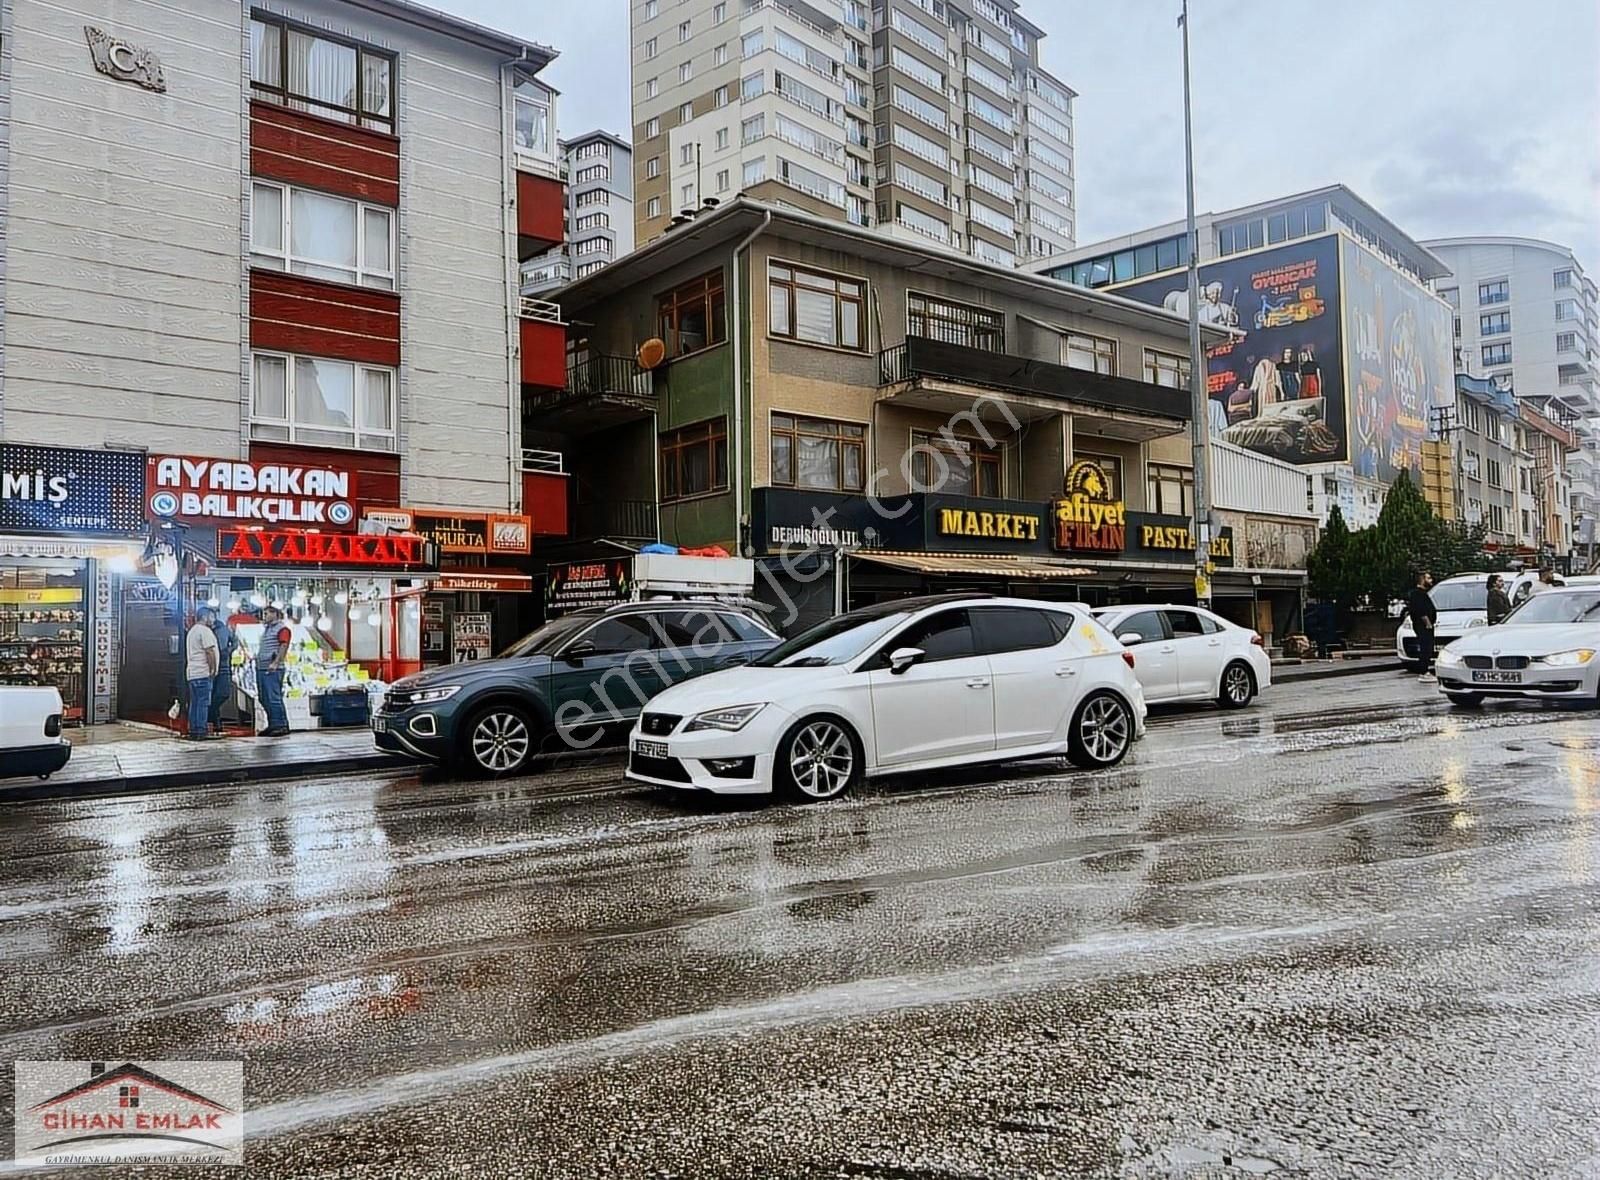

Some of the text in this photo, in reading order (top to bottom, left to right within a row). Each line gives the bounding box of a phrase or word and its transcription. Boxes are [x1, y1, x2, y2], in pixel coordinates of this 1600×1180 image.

[1253, 267, 1317, 290] OYUNCAK
[157, 458, 349, 498] AYABAKAN
[181, 493, 326, 523] BALIKÇILIK
[1057, 494, 1125, 531] afiyet
[940, 509, 1039, 541] MARKET
[230, 531, 413, 563] AYABAKAN
